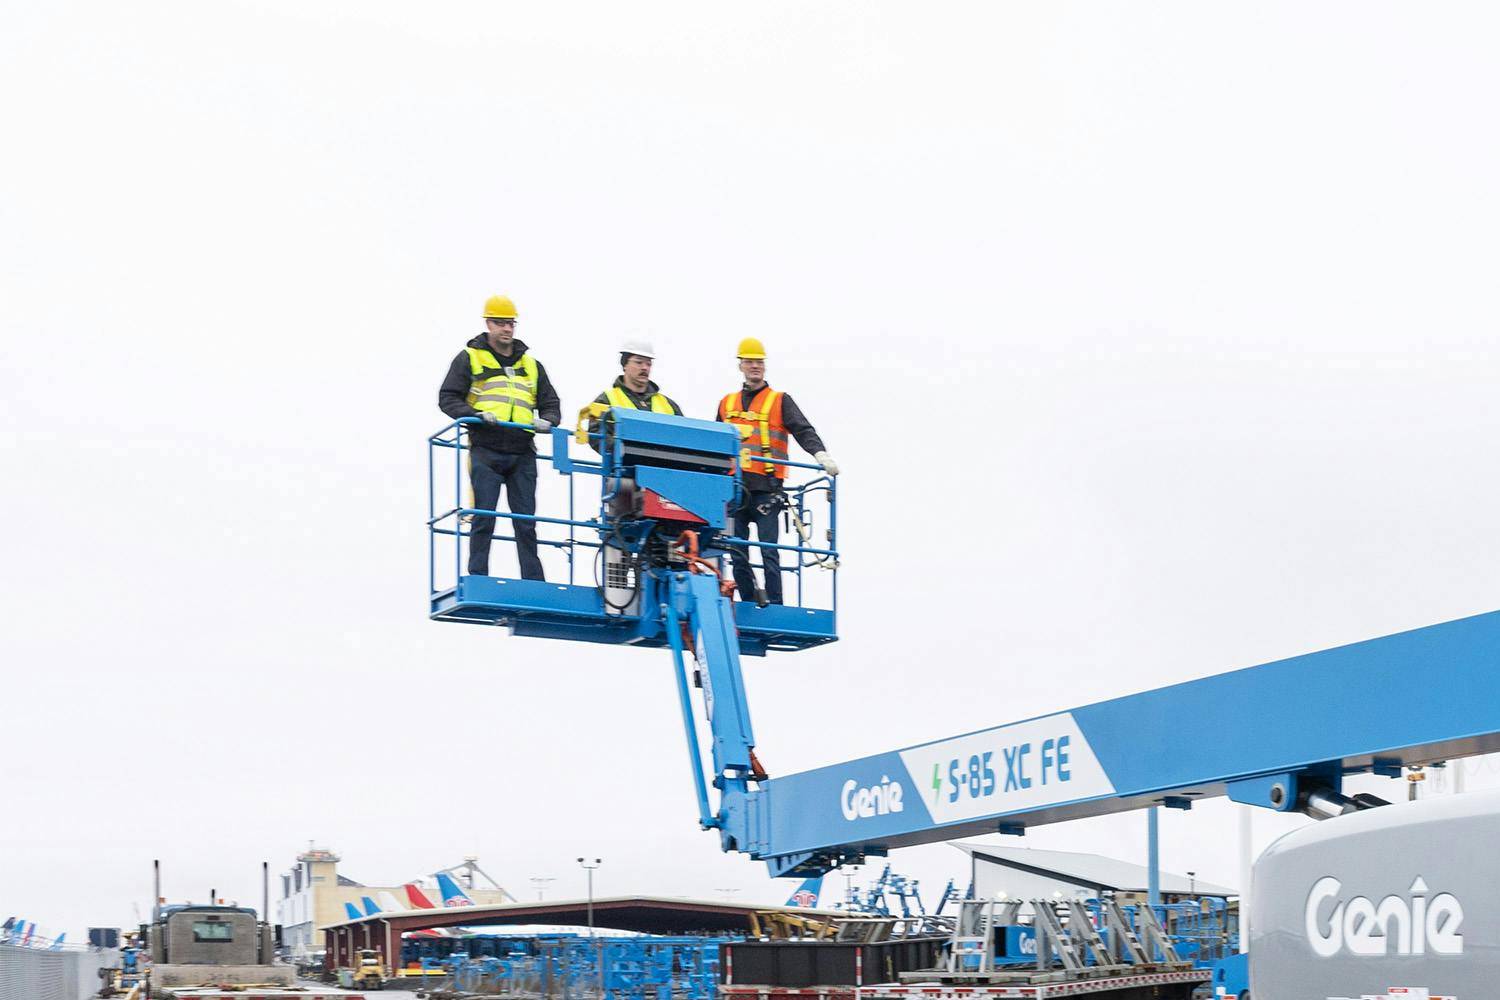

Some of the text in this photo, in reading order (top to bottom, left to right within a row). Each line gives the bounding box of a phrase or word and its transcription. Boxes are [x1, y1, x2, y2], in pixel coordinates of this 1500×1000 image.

[841, 774, 903, 821] Genie
[948, 735, 1070, 803] S-85 XC FE
[1305, 874, 1464, 957] Genie
